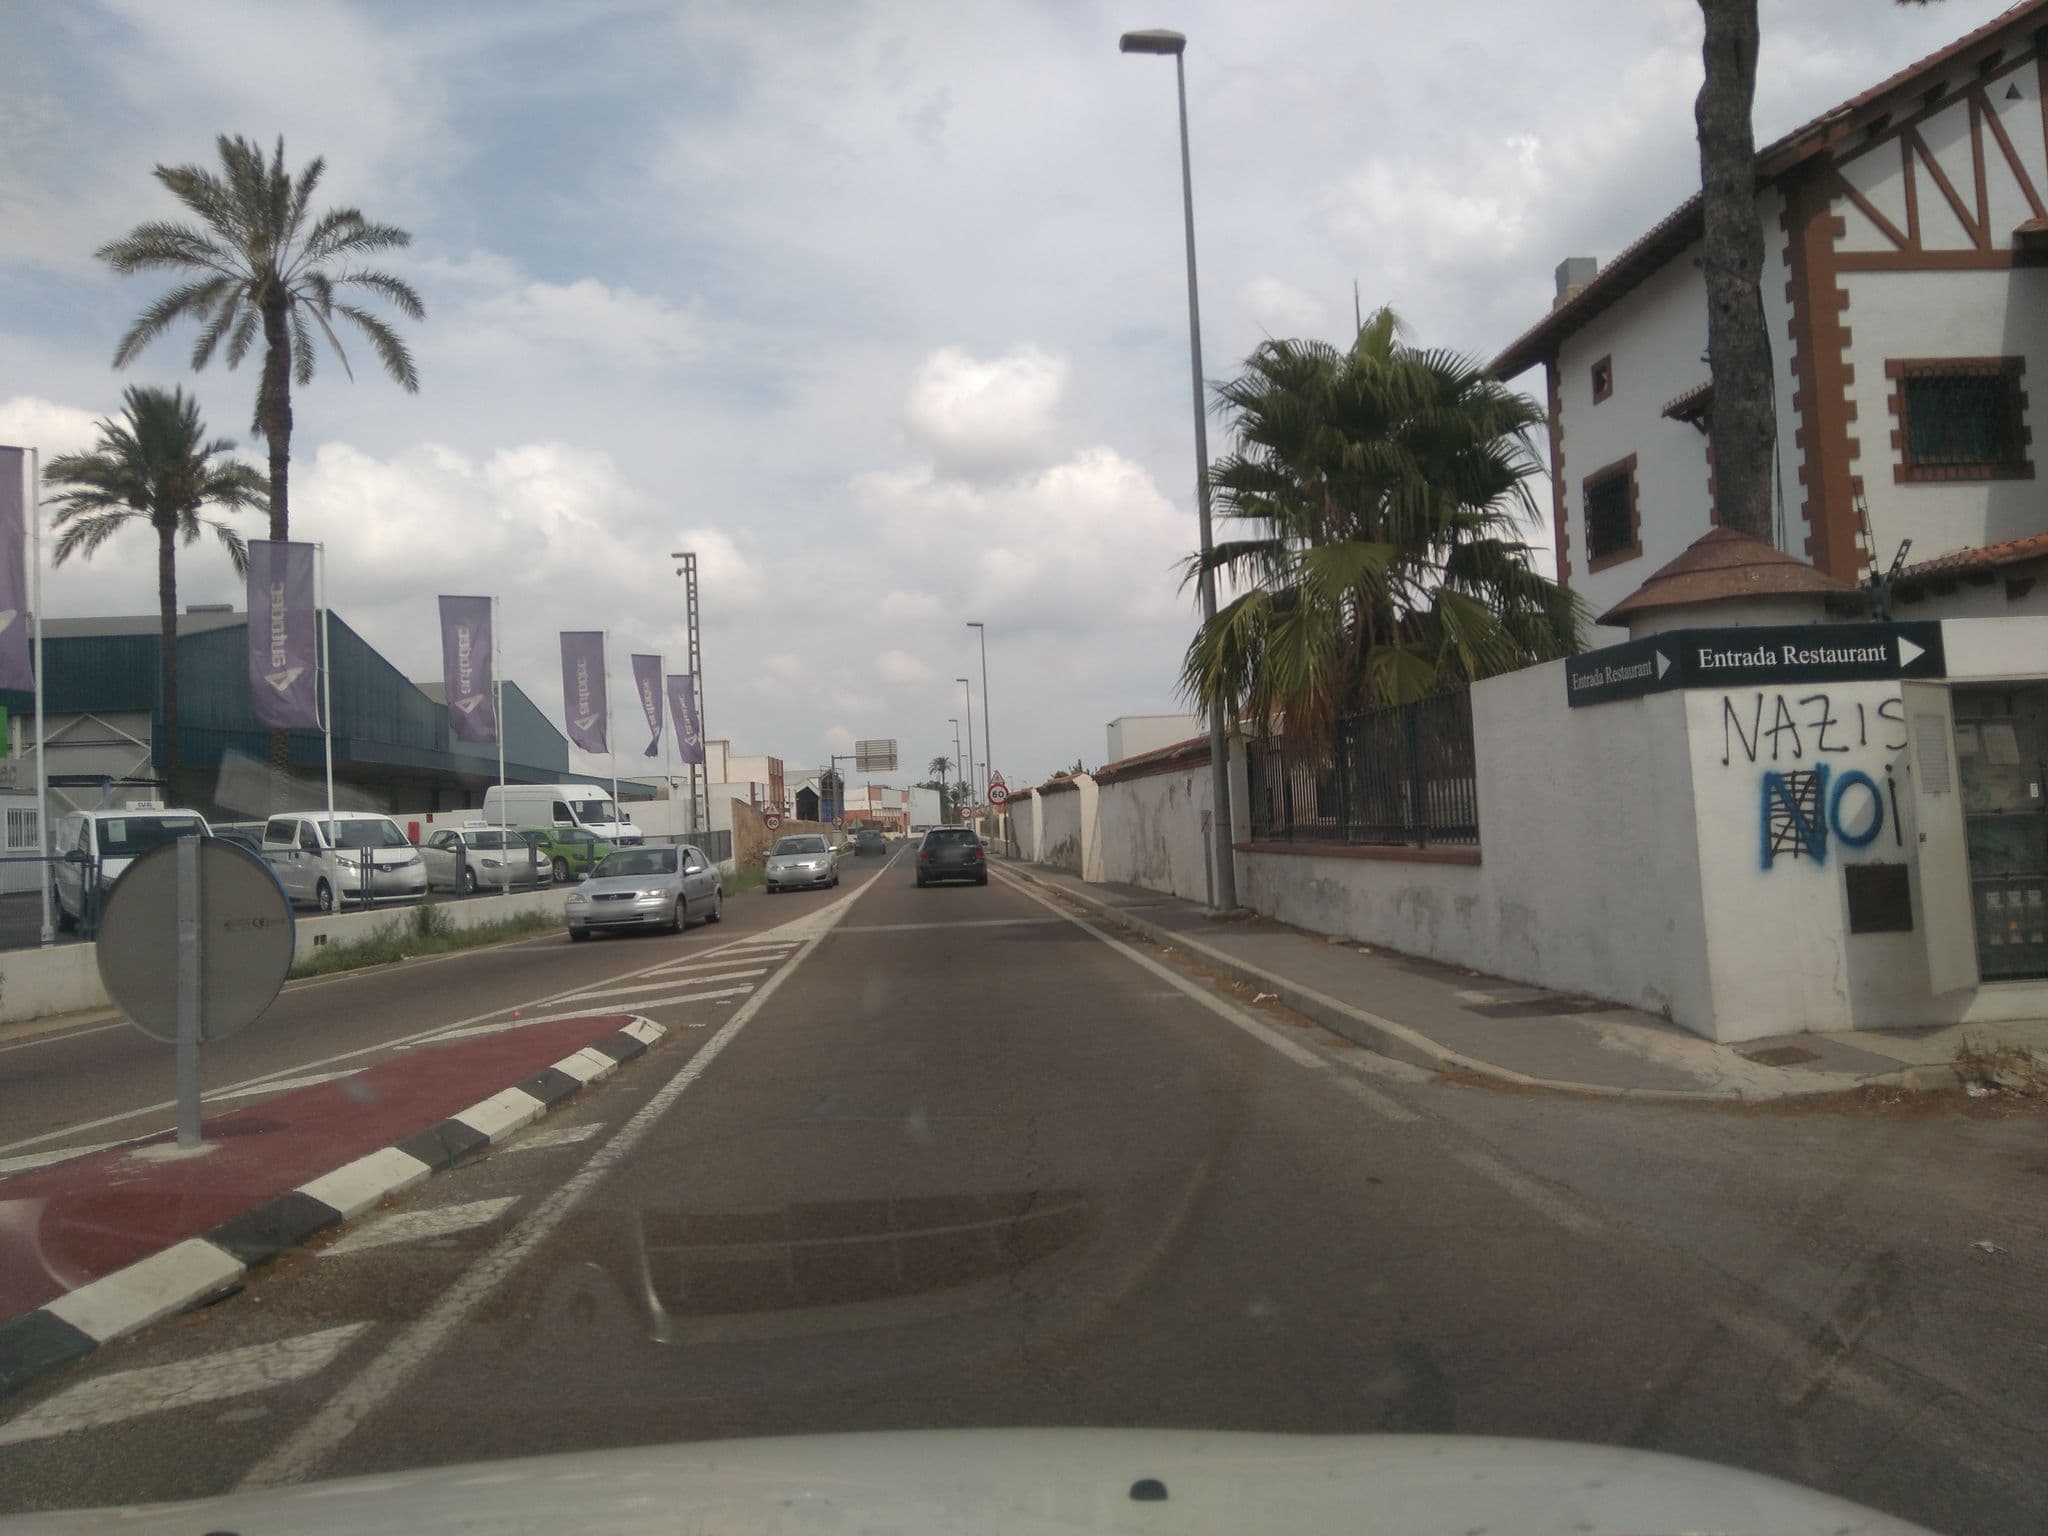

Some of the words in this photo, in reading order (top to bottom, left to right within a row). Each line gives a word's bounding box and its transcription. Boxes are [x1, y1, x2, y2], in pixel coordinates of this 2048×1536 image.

[1698, 646, 1777, 668] Entrada
[1782, 644, 1887, 665] Restaurant
[1572, 668, 1604, 690] Entrada
[1605, 660, 1653, 684] Restaurant
[1722, 693, 1908, 766] NAZIS
[992, 790, 1004, 798] 60
